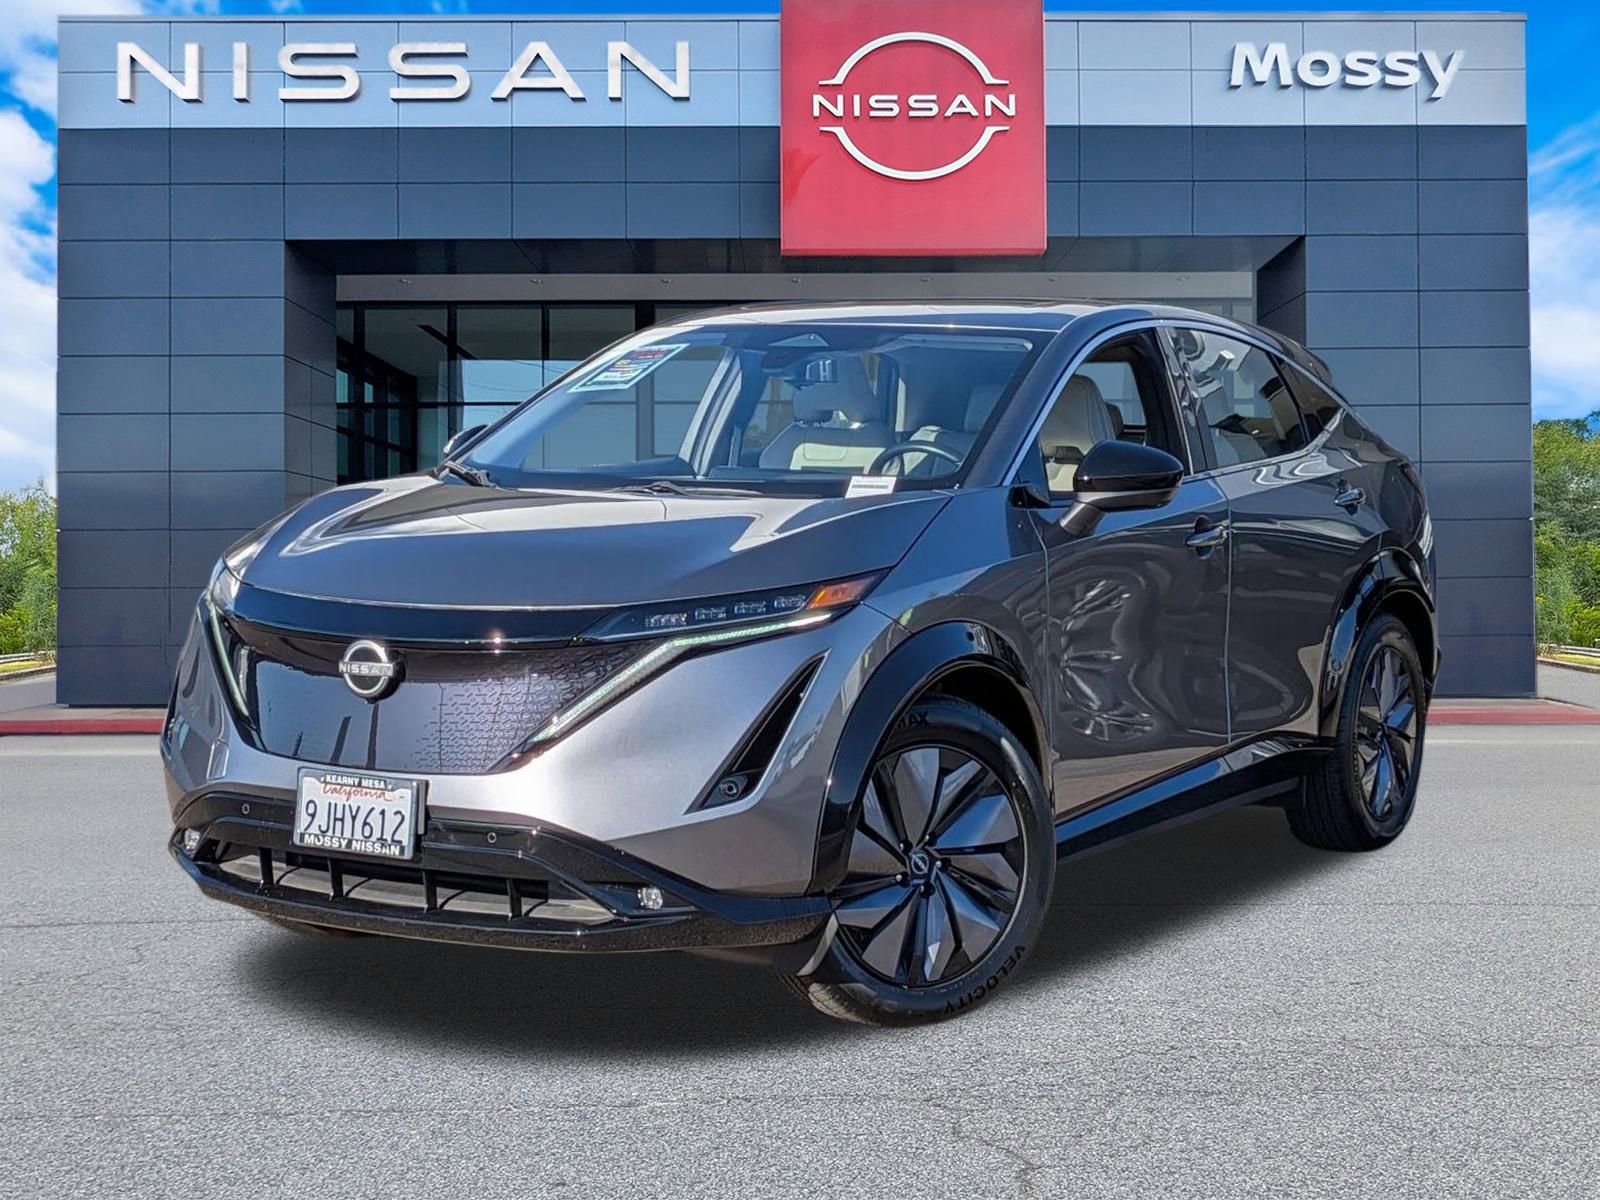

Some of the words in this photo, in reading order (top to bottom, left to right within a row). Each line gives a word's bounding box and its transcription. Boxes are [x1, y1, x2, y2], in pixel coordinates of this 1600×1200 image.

[117, 41, 690, 101] NISSAN
[1229, 42, 1466, 99] Mossy
[812, 94, 1016, 117] NISSAN
[338, 660, 393, 676] NISSAN
[325, 774, 360, 787] KEARNY
[361, 778, 385, 789] MESA
[303, 799, 405, 844] 9JHY612
[304, 834, 348, 849] MOSSY
[351, 839, 400, 856] NISSAN
[944, 945, 1025, 1014] VELOCITY
